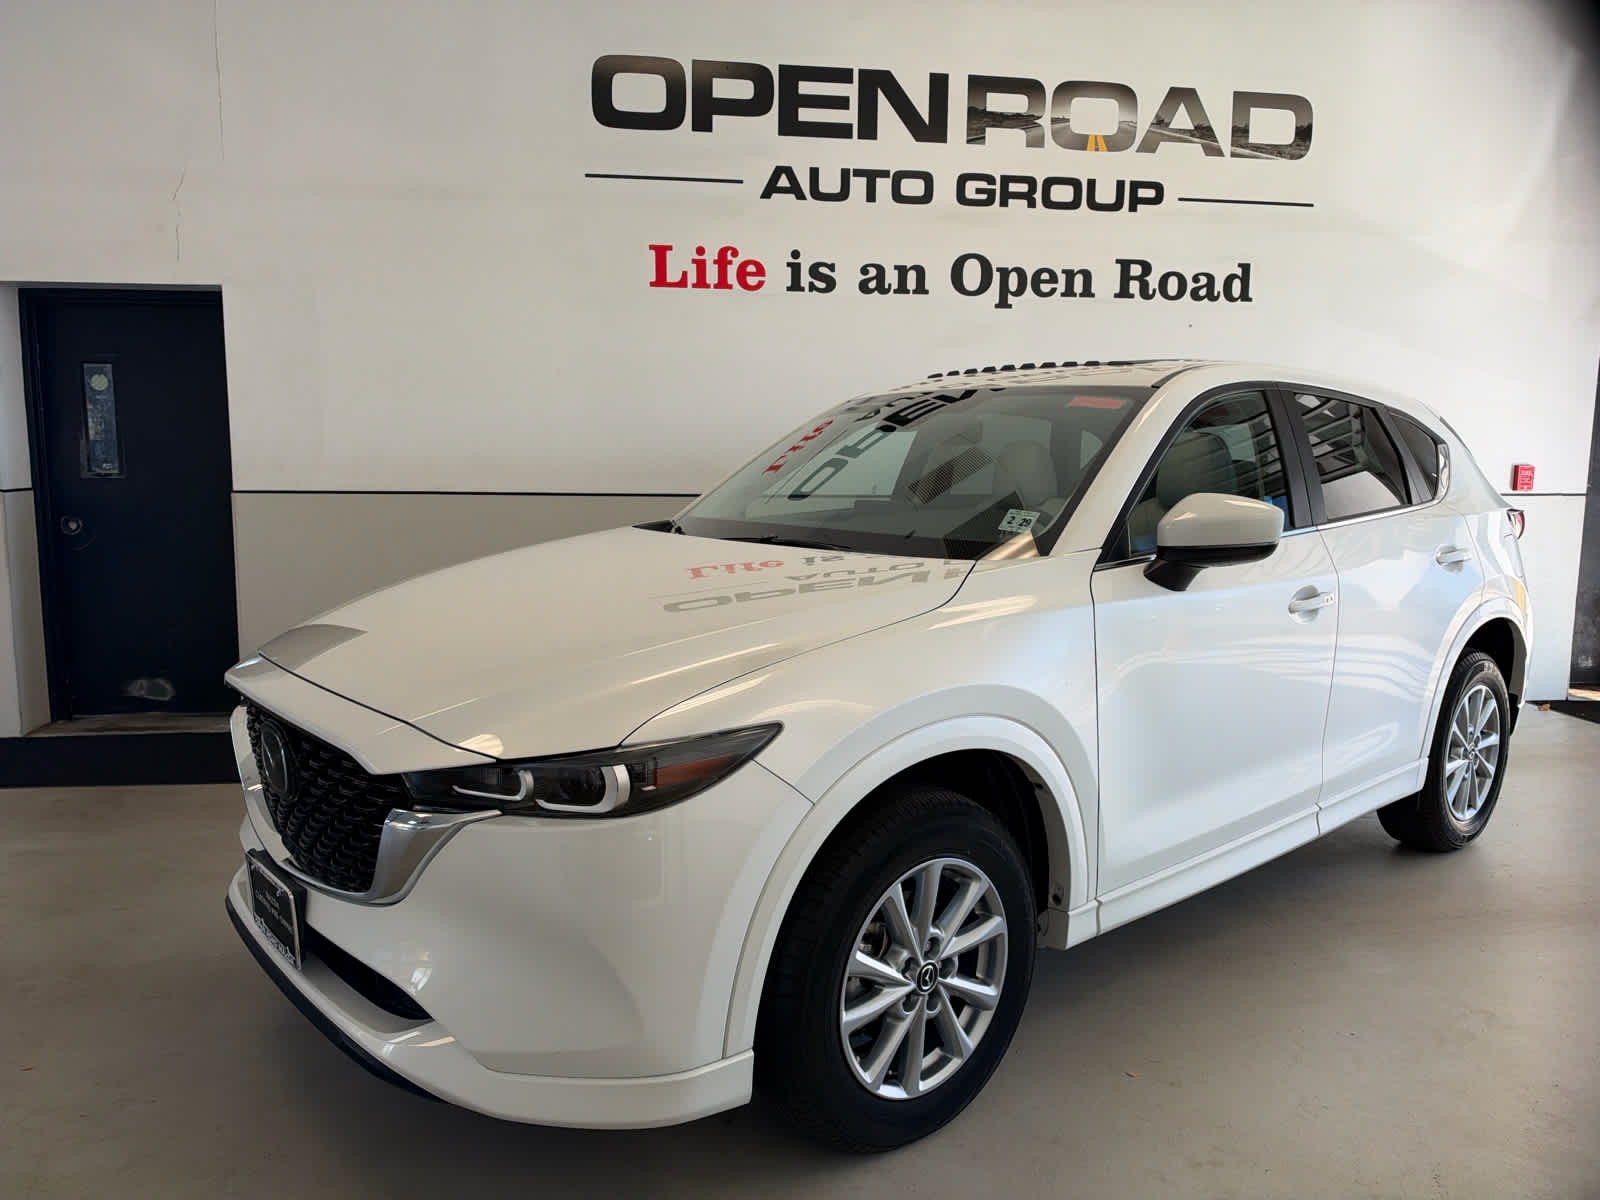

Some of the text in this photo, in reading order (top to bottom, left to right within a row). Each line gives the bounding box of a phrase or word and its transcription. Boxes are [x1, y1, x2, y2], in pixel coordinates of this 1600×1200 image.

[590, 54, 1314, 161] OPEN ROAD
[759, 165, 1165, 213] AUTO GROUP
[648, 244, 1253, 309] Life is an Open Road
